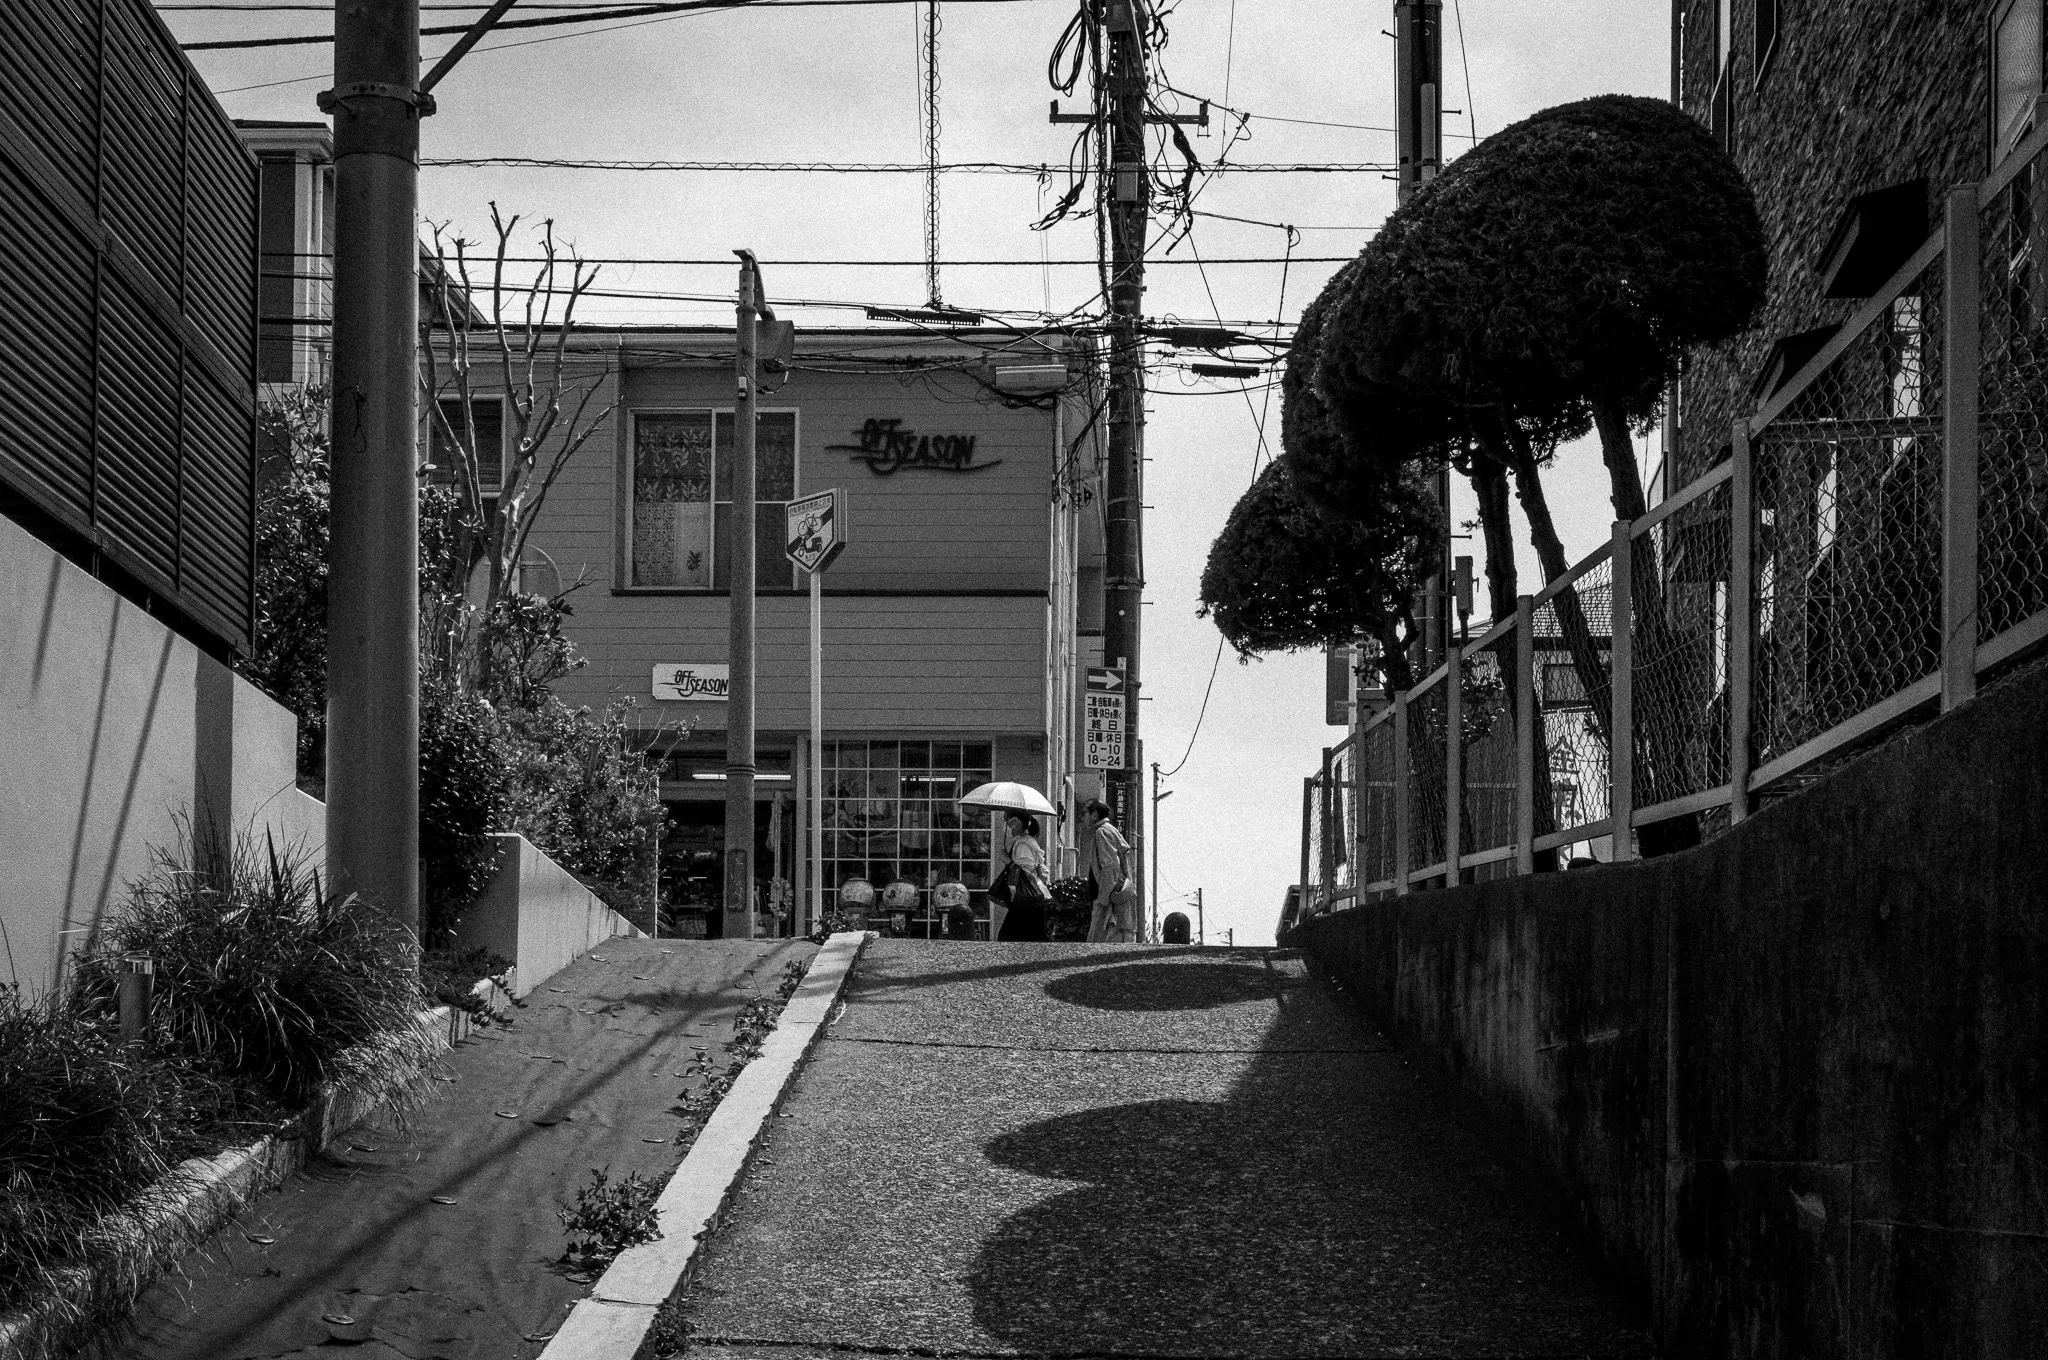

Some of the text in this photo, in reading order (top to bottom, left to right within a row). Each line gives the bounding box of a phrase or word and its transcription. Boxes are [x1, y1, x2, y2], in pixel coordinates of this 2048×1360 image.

[888, 435, 976, 470] SEASON
[674, 669, 729, 697] OFF SEASON
